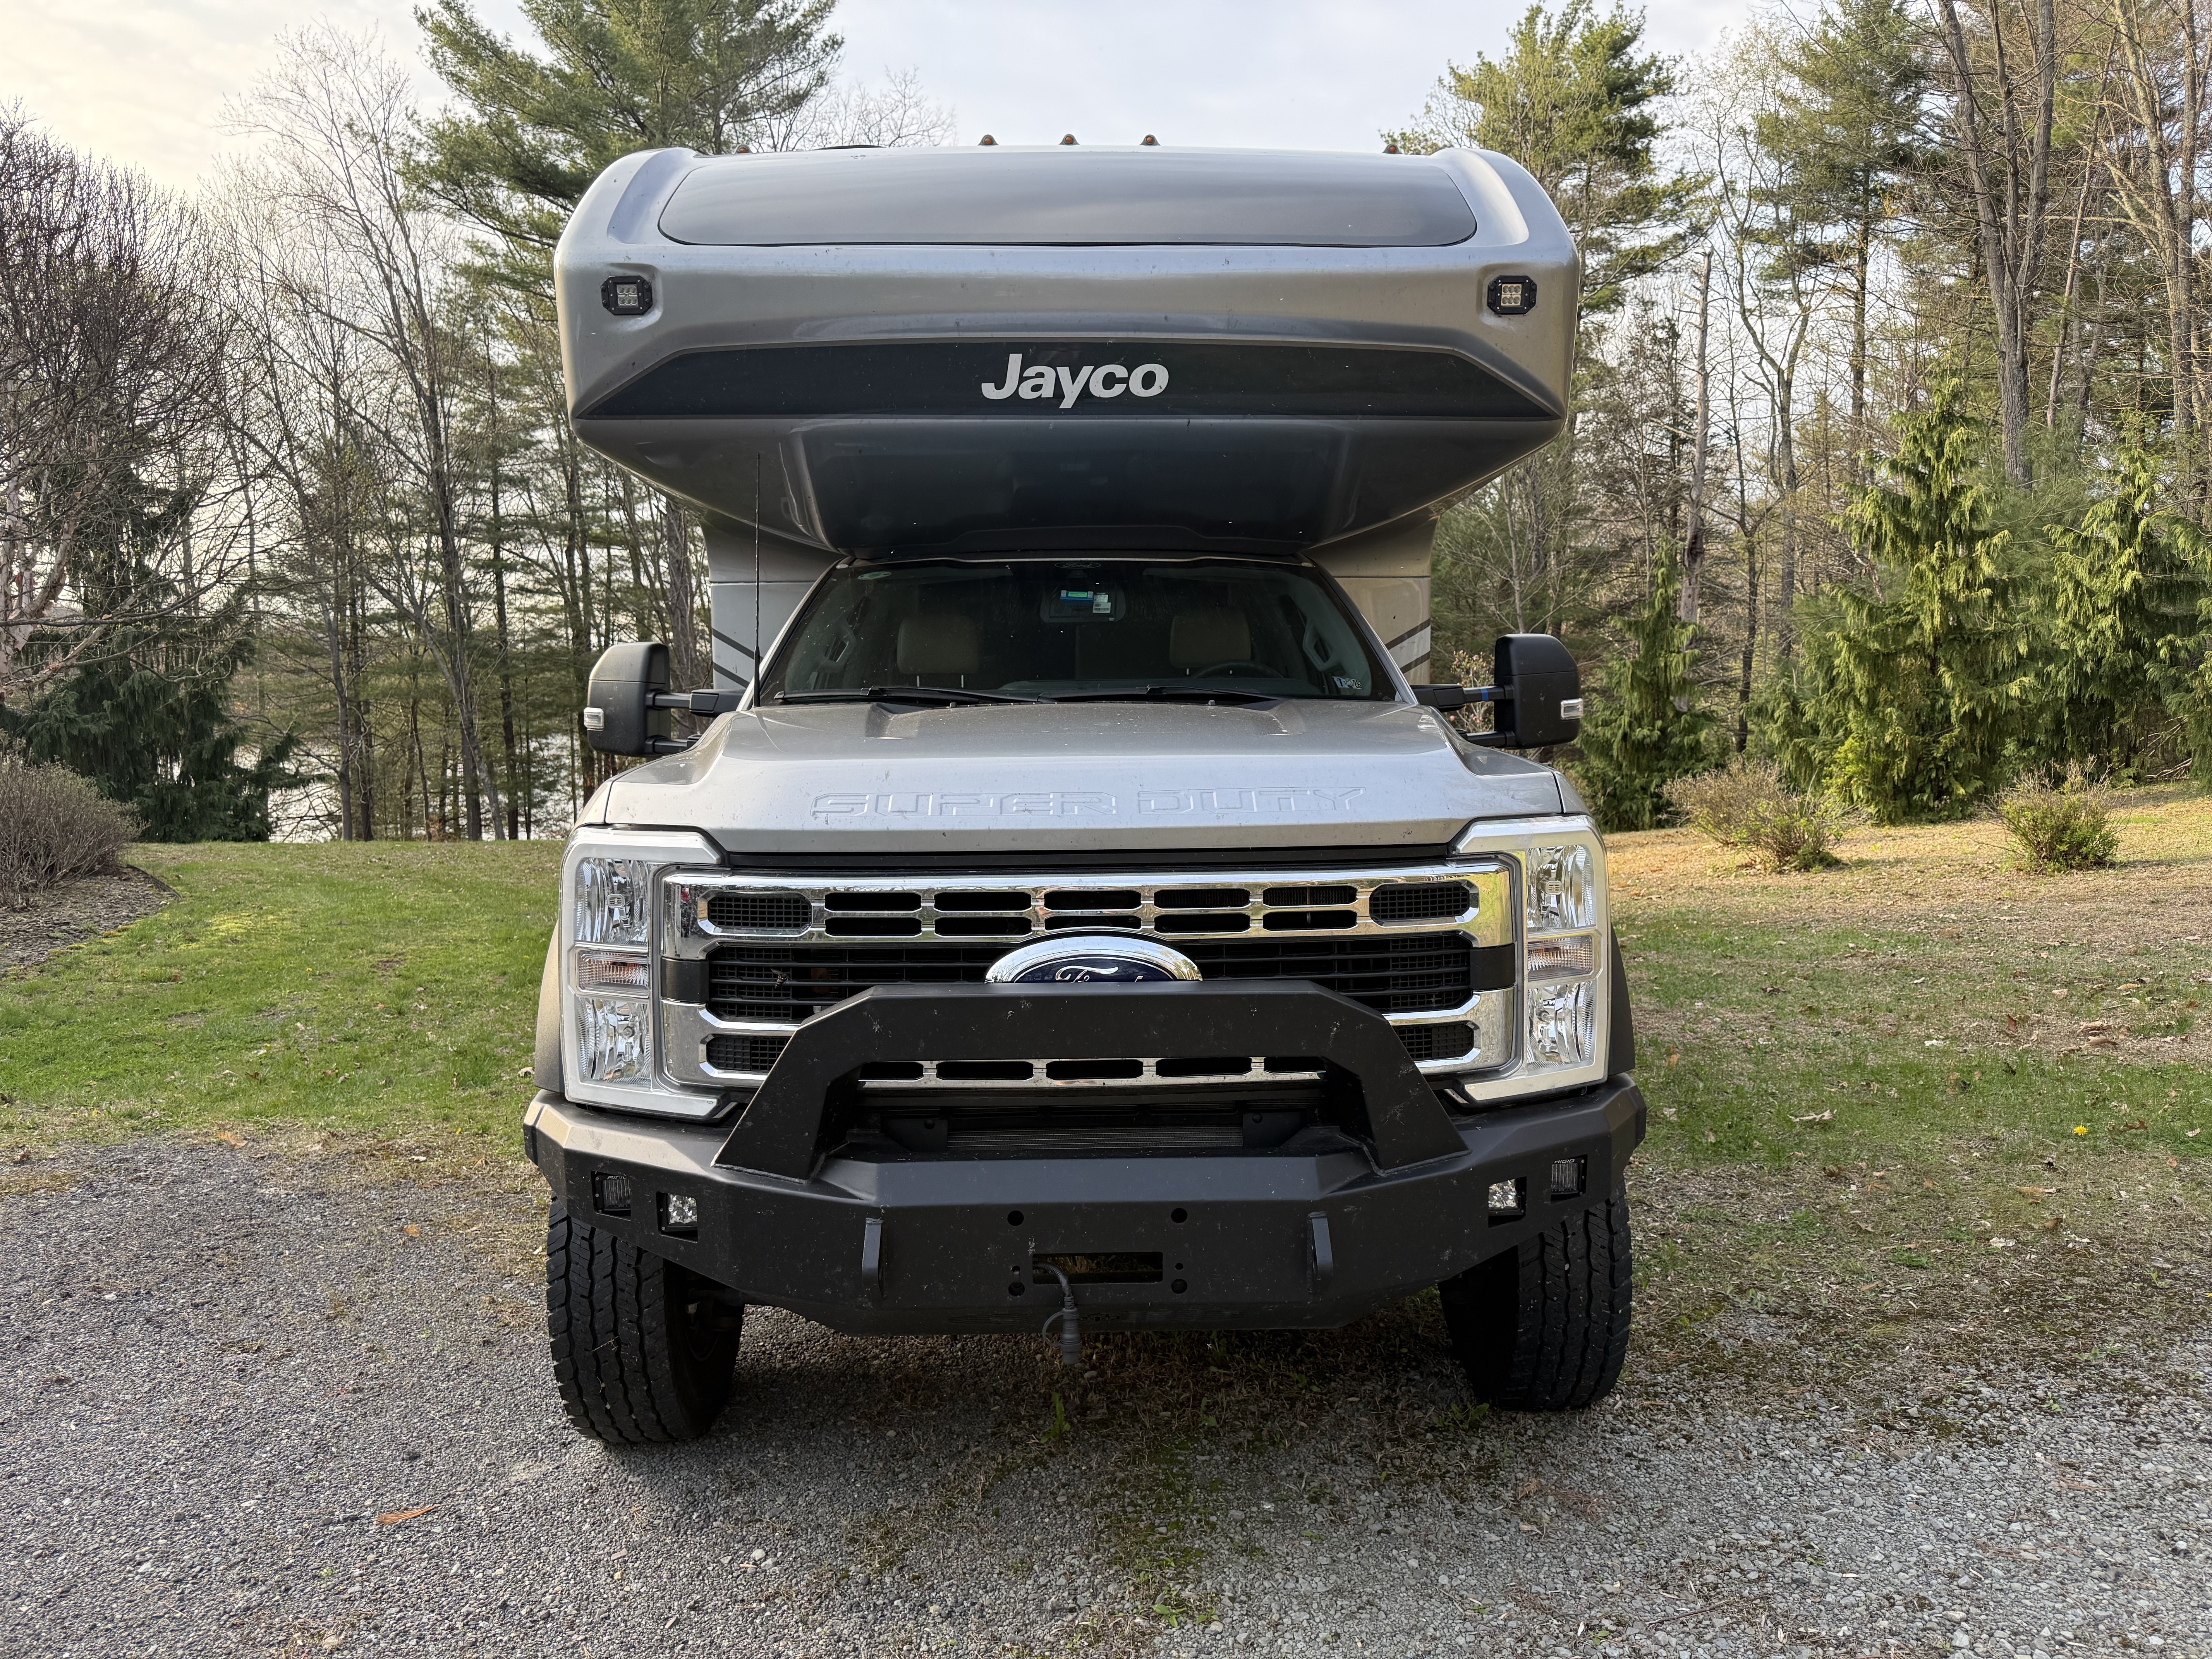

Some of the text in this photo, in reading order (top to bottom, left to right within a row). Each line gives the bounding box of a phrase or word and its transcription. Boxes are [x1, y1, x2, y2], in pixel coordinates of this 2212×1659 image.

[981, 353, 1169, 409] Jayco
[1352, 680, 1362, 688] 26
[810, 787, 1366, 816] SUPER DUTY
